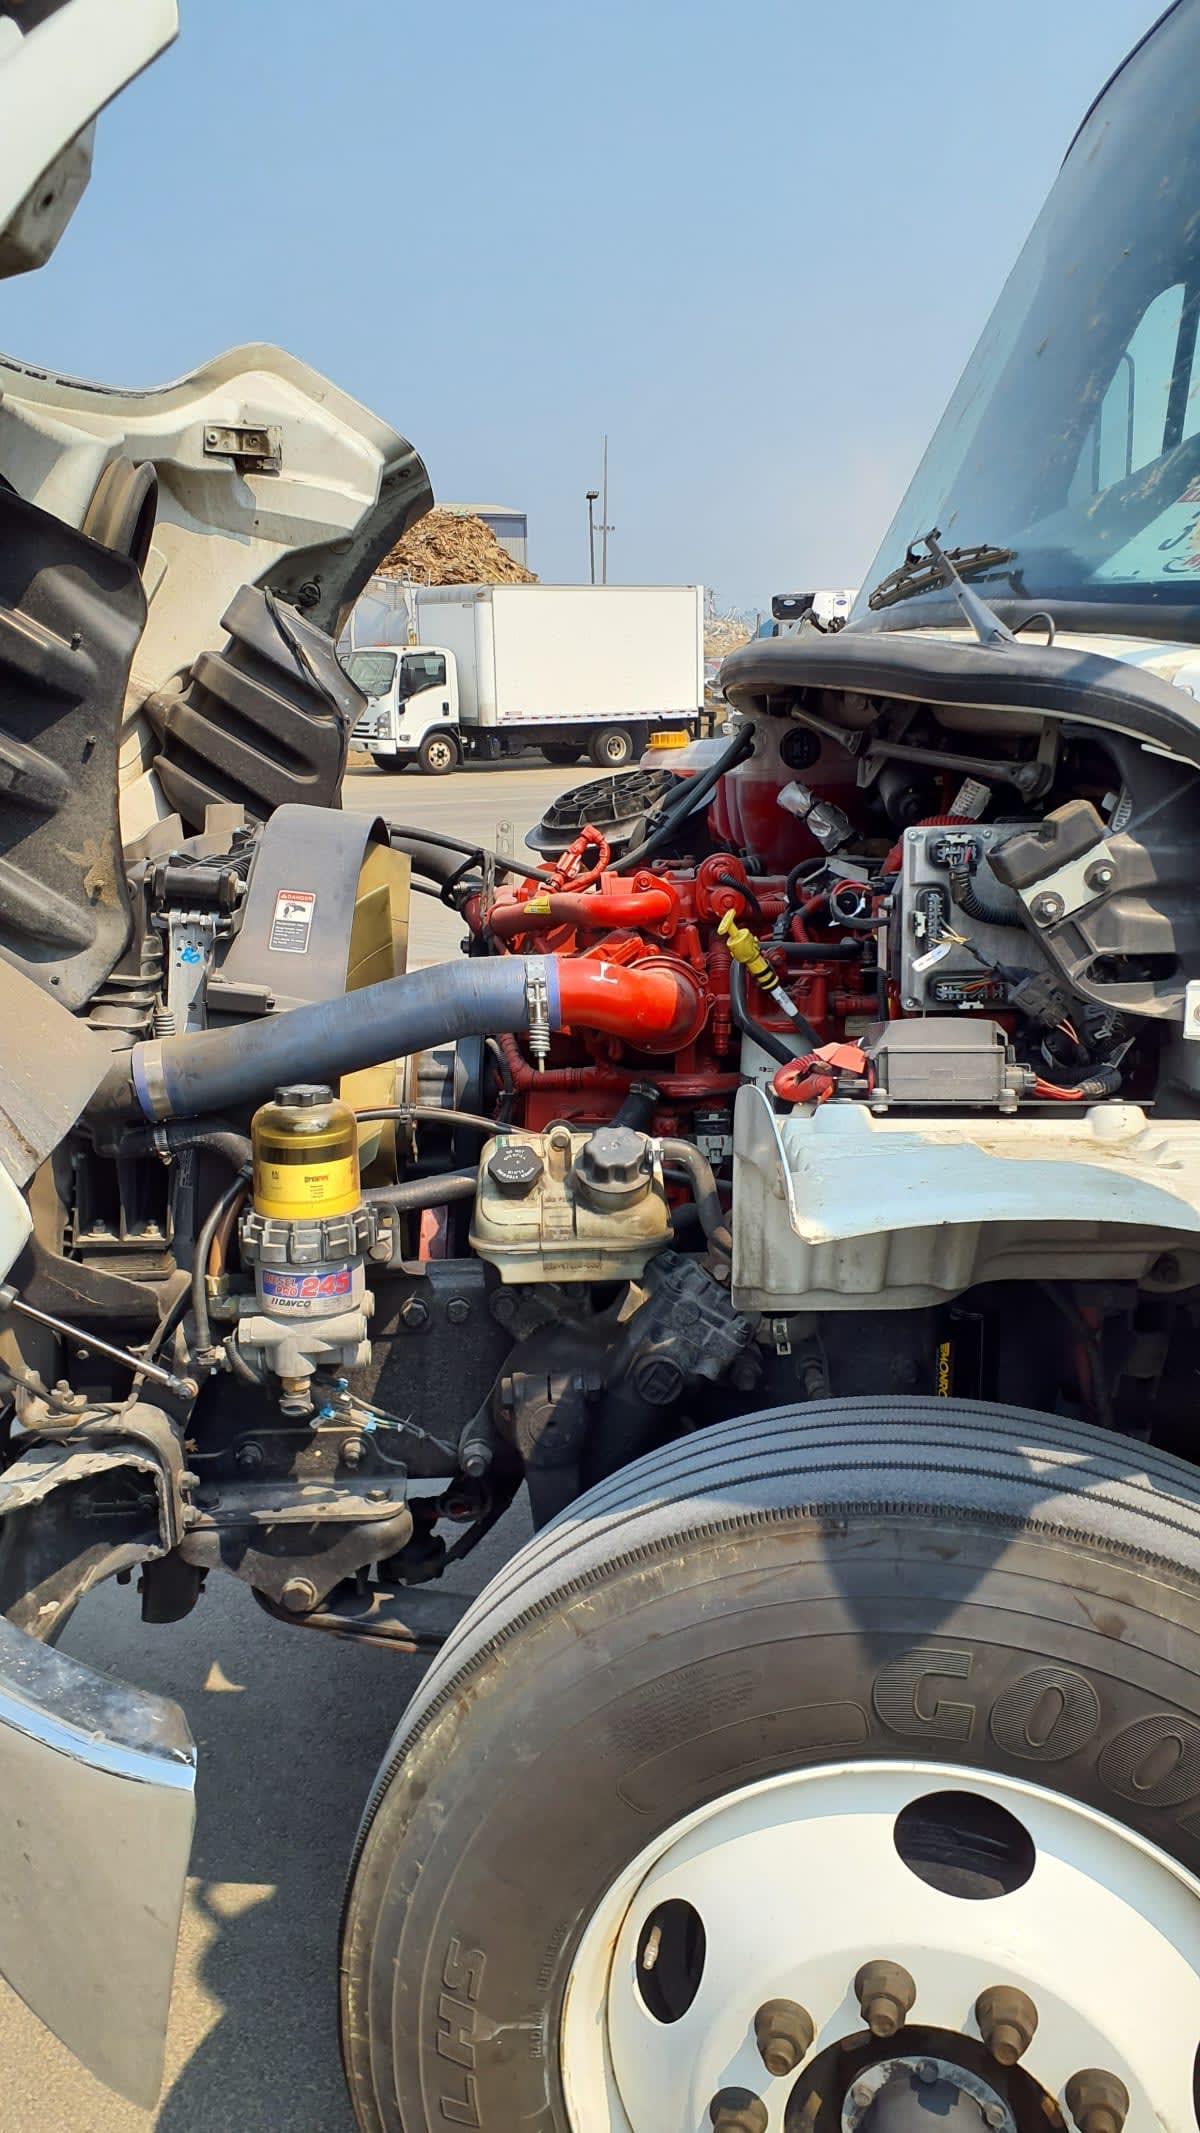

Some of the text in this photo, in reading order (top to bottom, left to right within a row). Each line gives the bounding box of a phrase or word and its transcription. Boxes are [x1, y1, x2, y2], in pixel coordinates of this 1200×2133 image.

[287, 894, 313, 902] DANGER
[264, 1270, 350, 1298] DIESEL 245
[275, 1285, 299, 1298] PRO
[437, 1937, 487, 2128] LHS
